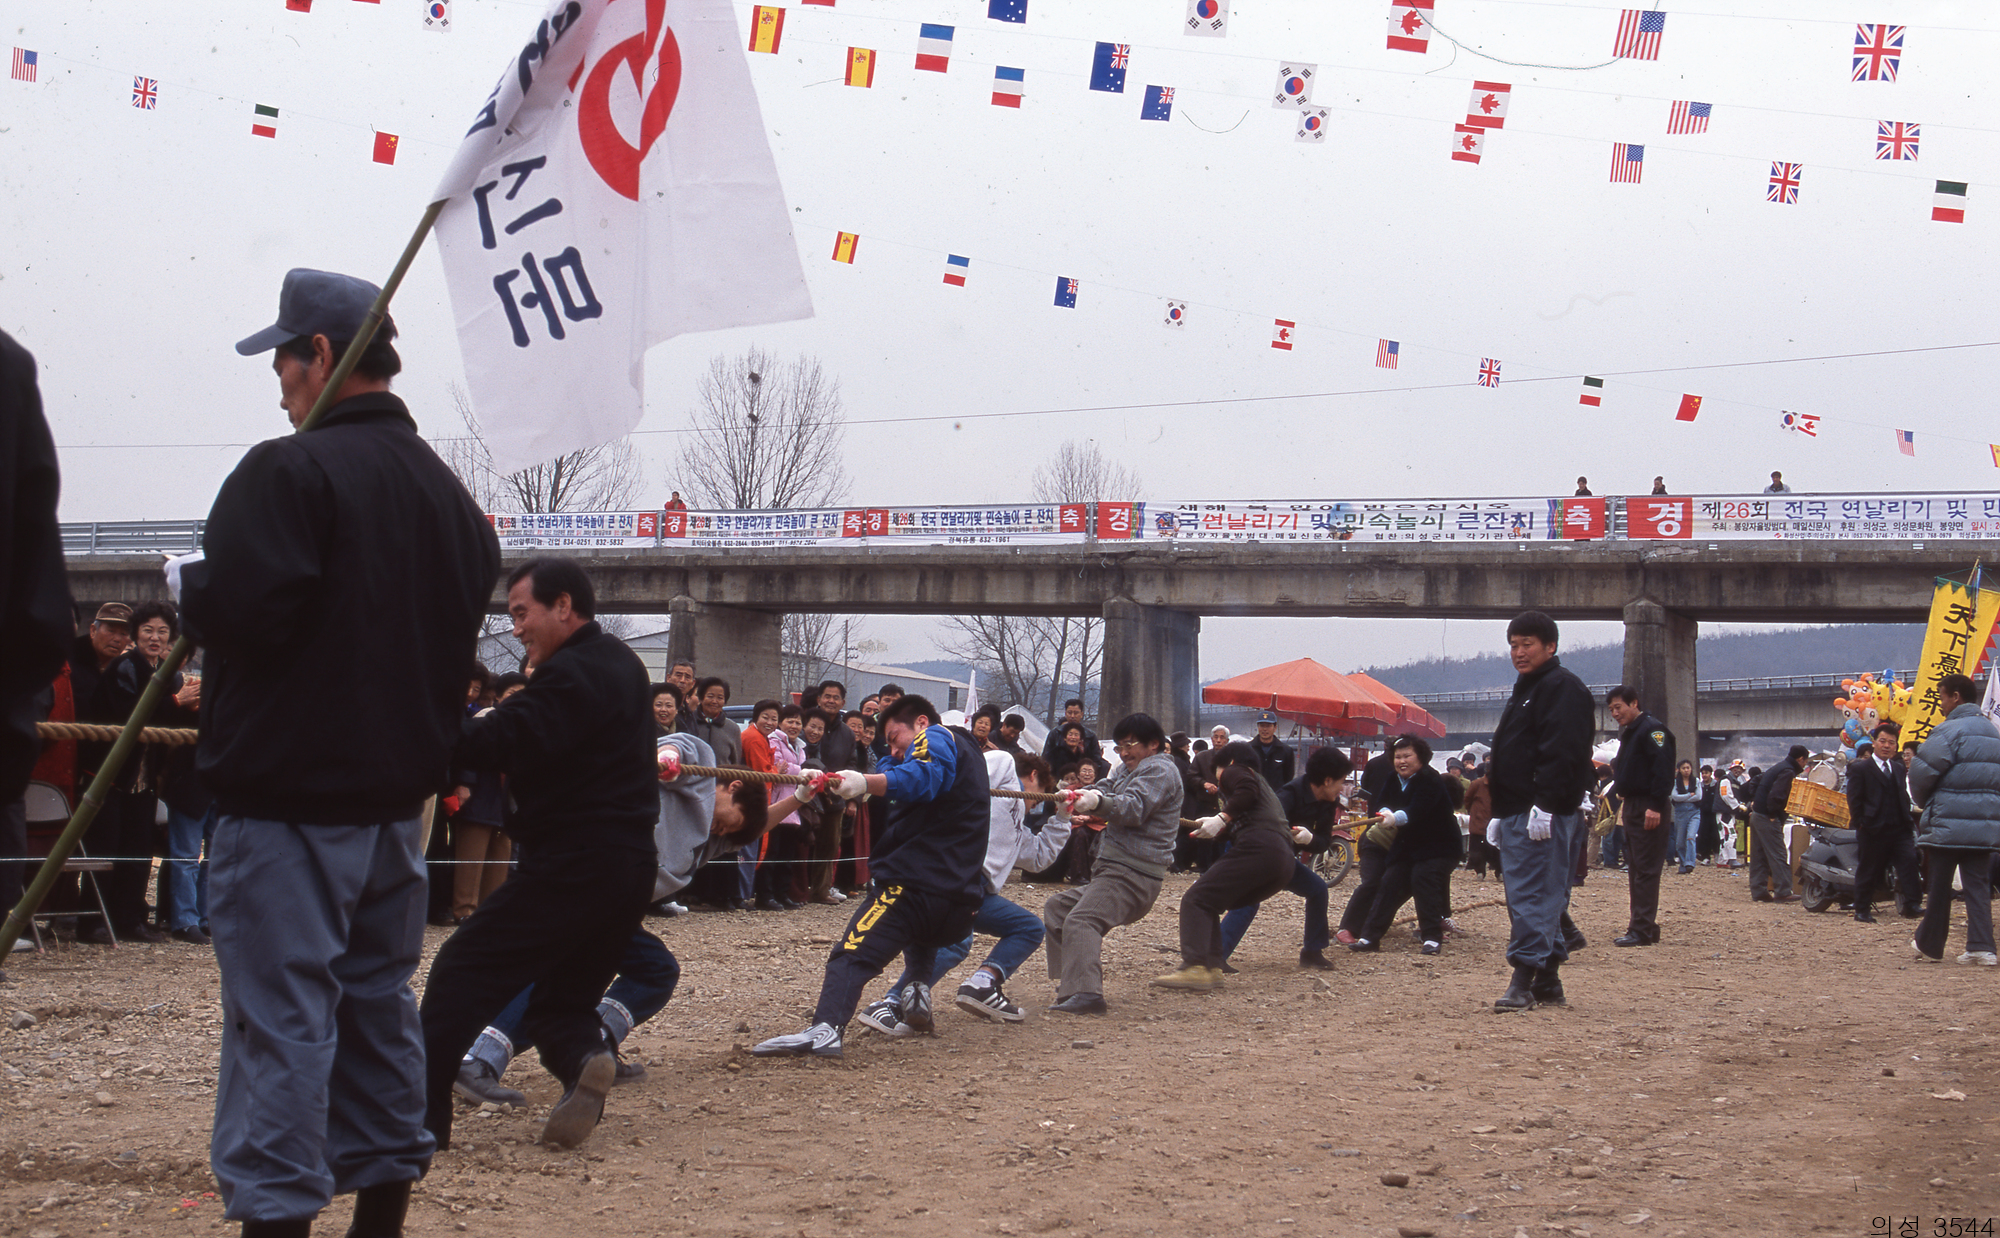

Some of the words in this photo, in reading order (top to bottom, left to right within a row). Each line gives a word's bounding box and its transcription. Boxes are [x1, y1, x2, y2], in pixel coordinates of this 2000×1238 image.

[521, 515, 534, 529] 전국
[639, 517, 654, 534] 축
[668, 516, 681, 533] 경
[845, 514, 861, 532] 축
[868, 513, 882, 531] 경
[921, 511, 936, 527] 전국
[986, 510, 1020, 525] 민속놀이
[1062, 509, 1079, 527] 축
[1108, 508, 1130, 531] 경
[1564, 505, 1592, 531] 축
[1647, 502, 1684, 537] 경
[1702, 501, 1770, 520] 제26회
[1784, 500, 1828, 520] 전국
[1841, 500, 1931, 520] 연날리기
[1947, 499, 1968, 519] 및
[1792, 522, 1831, 531] 매일신문사
[1840, 521, 1855, 531] 후원
[1939, 521, 1964, 531] 봉양면
[1971, 521, 1987, 531] 일시
